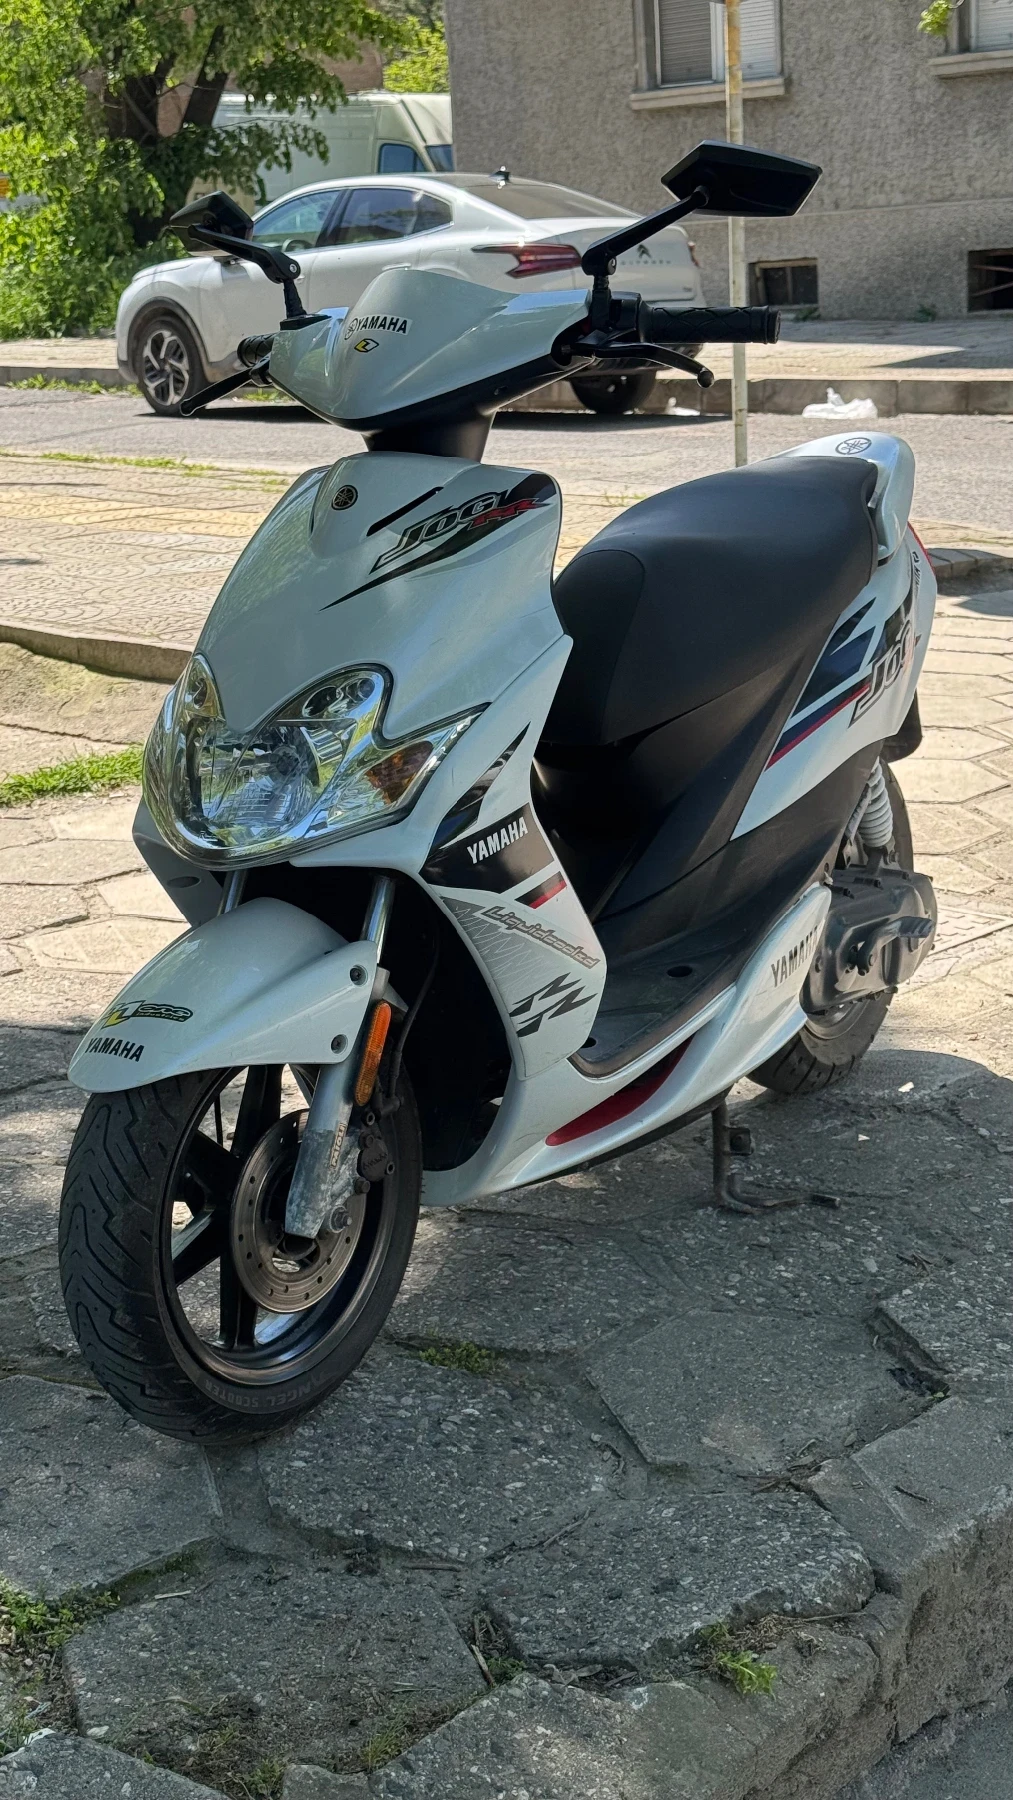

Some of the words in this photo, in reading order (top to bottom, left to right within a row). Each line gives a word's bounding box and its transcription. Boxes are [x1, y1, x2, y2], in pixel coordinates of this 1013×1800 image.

[356, 316, 408, 333] YAMAHA
[369, 489, 509, 574] JOG
[466, 816, 529, 864] YAMAHA
[85, 1038, 144, 1062] YAMAHA
[204, 1380, 259, 1407] SCOOTER
